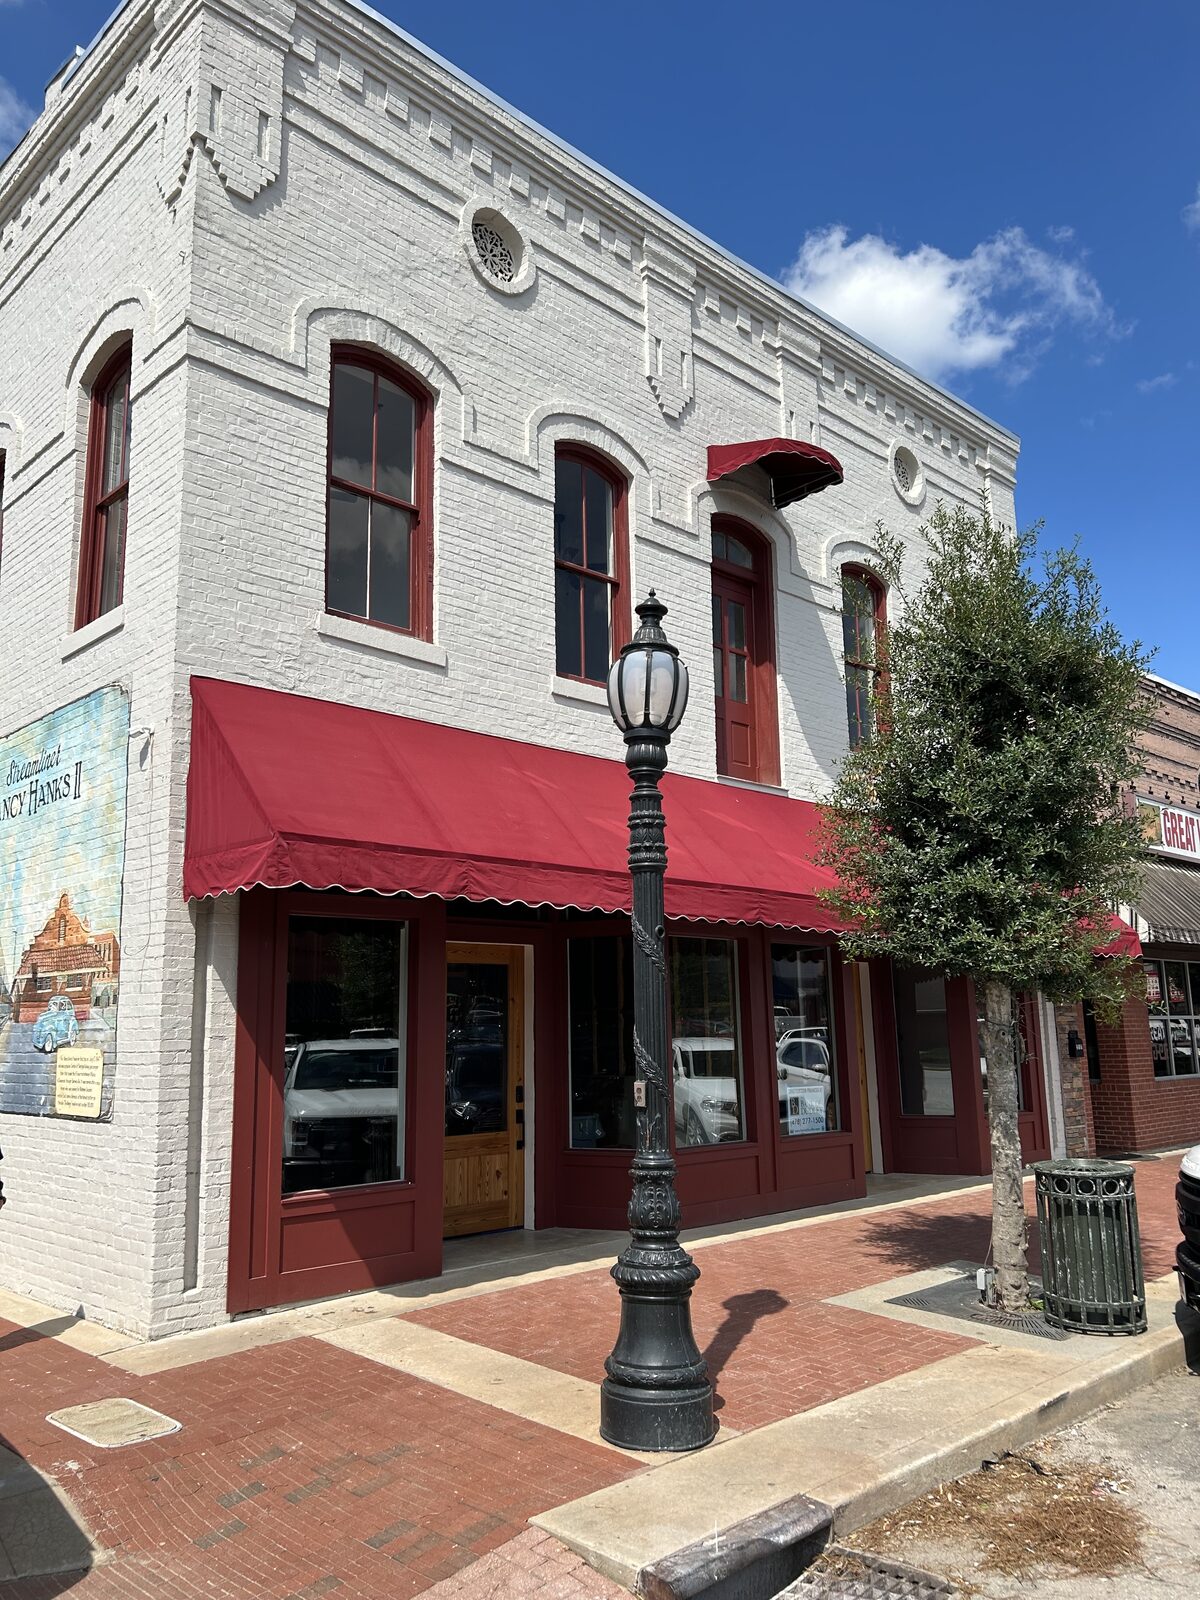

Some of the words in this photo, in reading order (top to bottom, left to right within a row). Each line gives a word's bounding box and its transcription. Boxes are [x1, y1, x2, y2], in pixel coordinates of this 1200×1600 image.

[0, 791, 26, 821] NCY
[73, 761, 82, 800] II
[1163, 809, 1196, 852] GREAT
[802, 1116, 824, 1125] 277-1500
